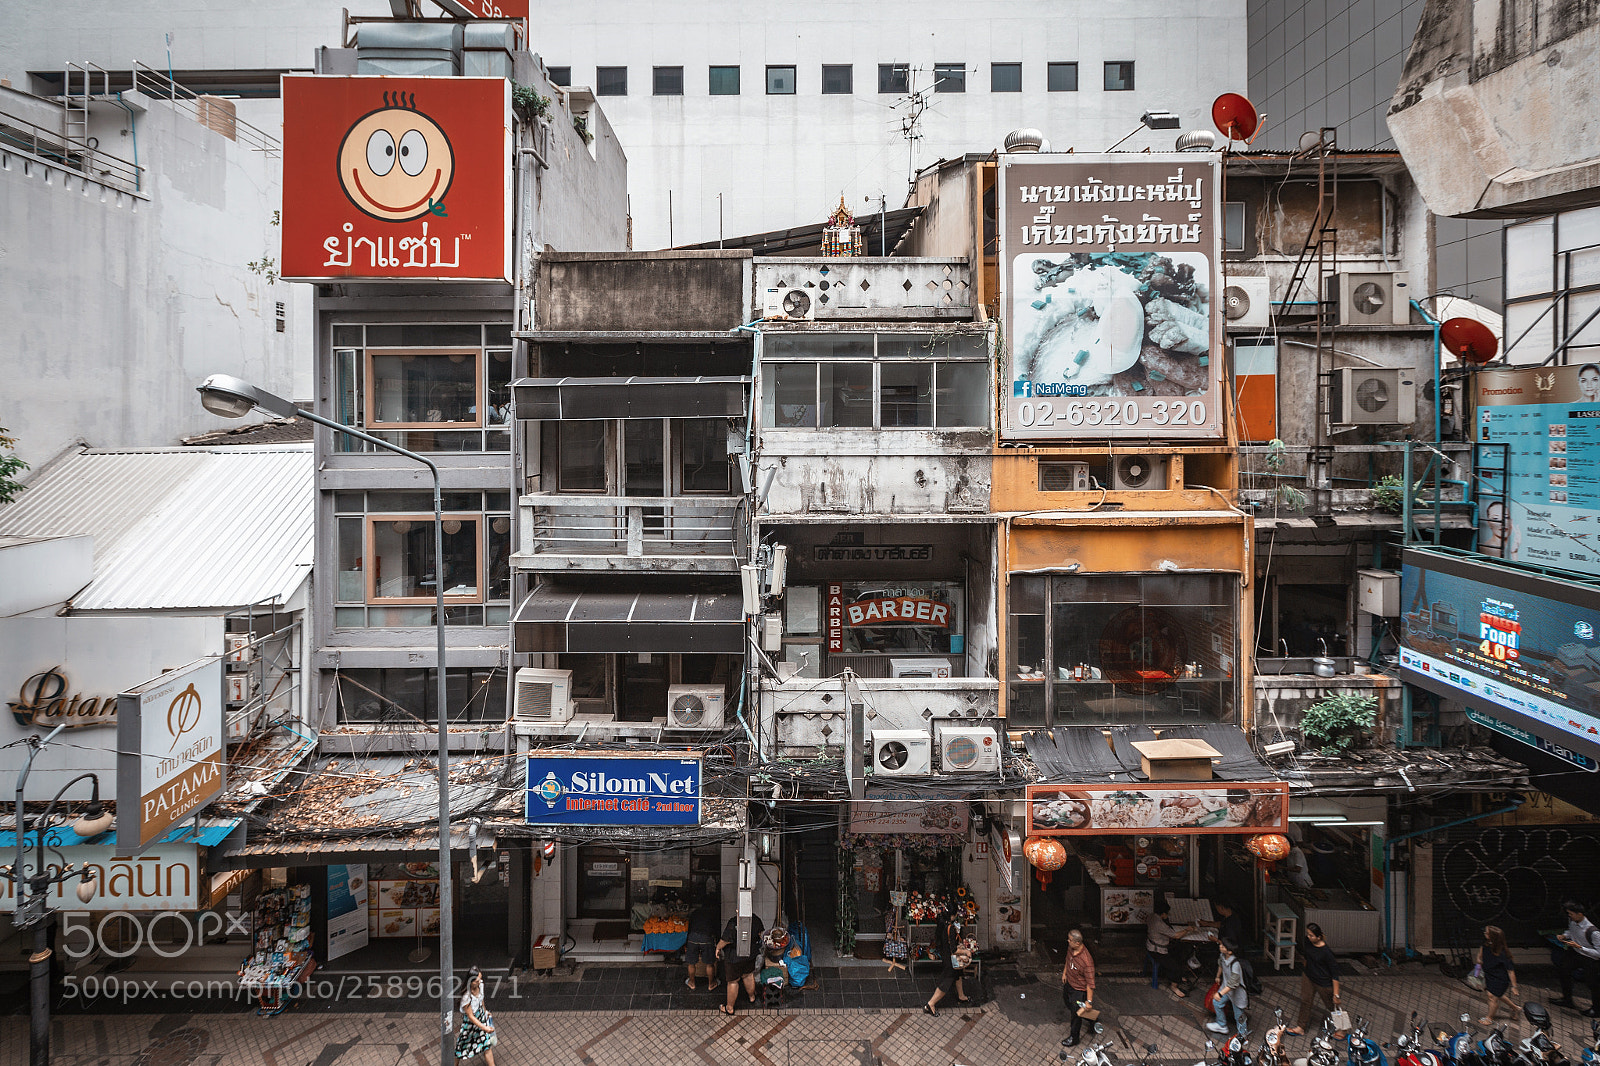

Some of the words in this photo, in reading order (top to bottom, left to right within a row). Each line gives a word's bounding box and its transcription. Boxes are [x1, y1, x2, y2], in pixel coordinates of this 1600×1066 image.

[1019, 167, 1203, 209] นายเม้งบะหมี่ปู
[1020, 206, 1202, 252] เกี๊ยวกุ้งยักษ์
[323, 222, 460, 268] ยำแซ่บ
[1036, 383, 1087, 395] NaiMeng
[1482, 387, 1523, 396] Promotion
[1018, 400, 1206, 426] 02-6320-320
[830, 585, 841, 649] BARBER
[848, 600, 948, 624] BARBER
[1480, 622, 1516, 649] Food
[1480, 639, 1506, 661] 4.0
[1496, 719, 1530, 740] Bangkok
[144, 759, 220, 824] PATAMA
[566, 797, 619, 811] internet
[621, 797, 650, 811] café
[656, 802, 672, 812] 2nd
[674, 802, 694, 812] floor
[169, 794, 200, 821] CLINIC
